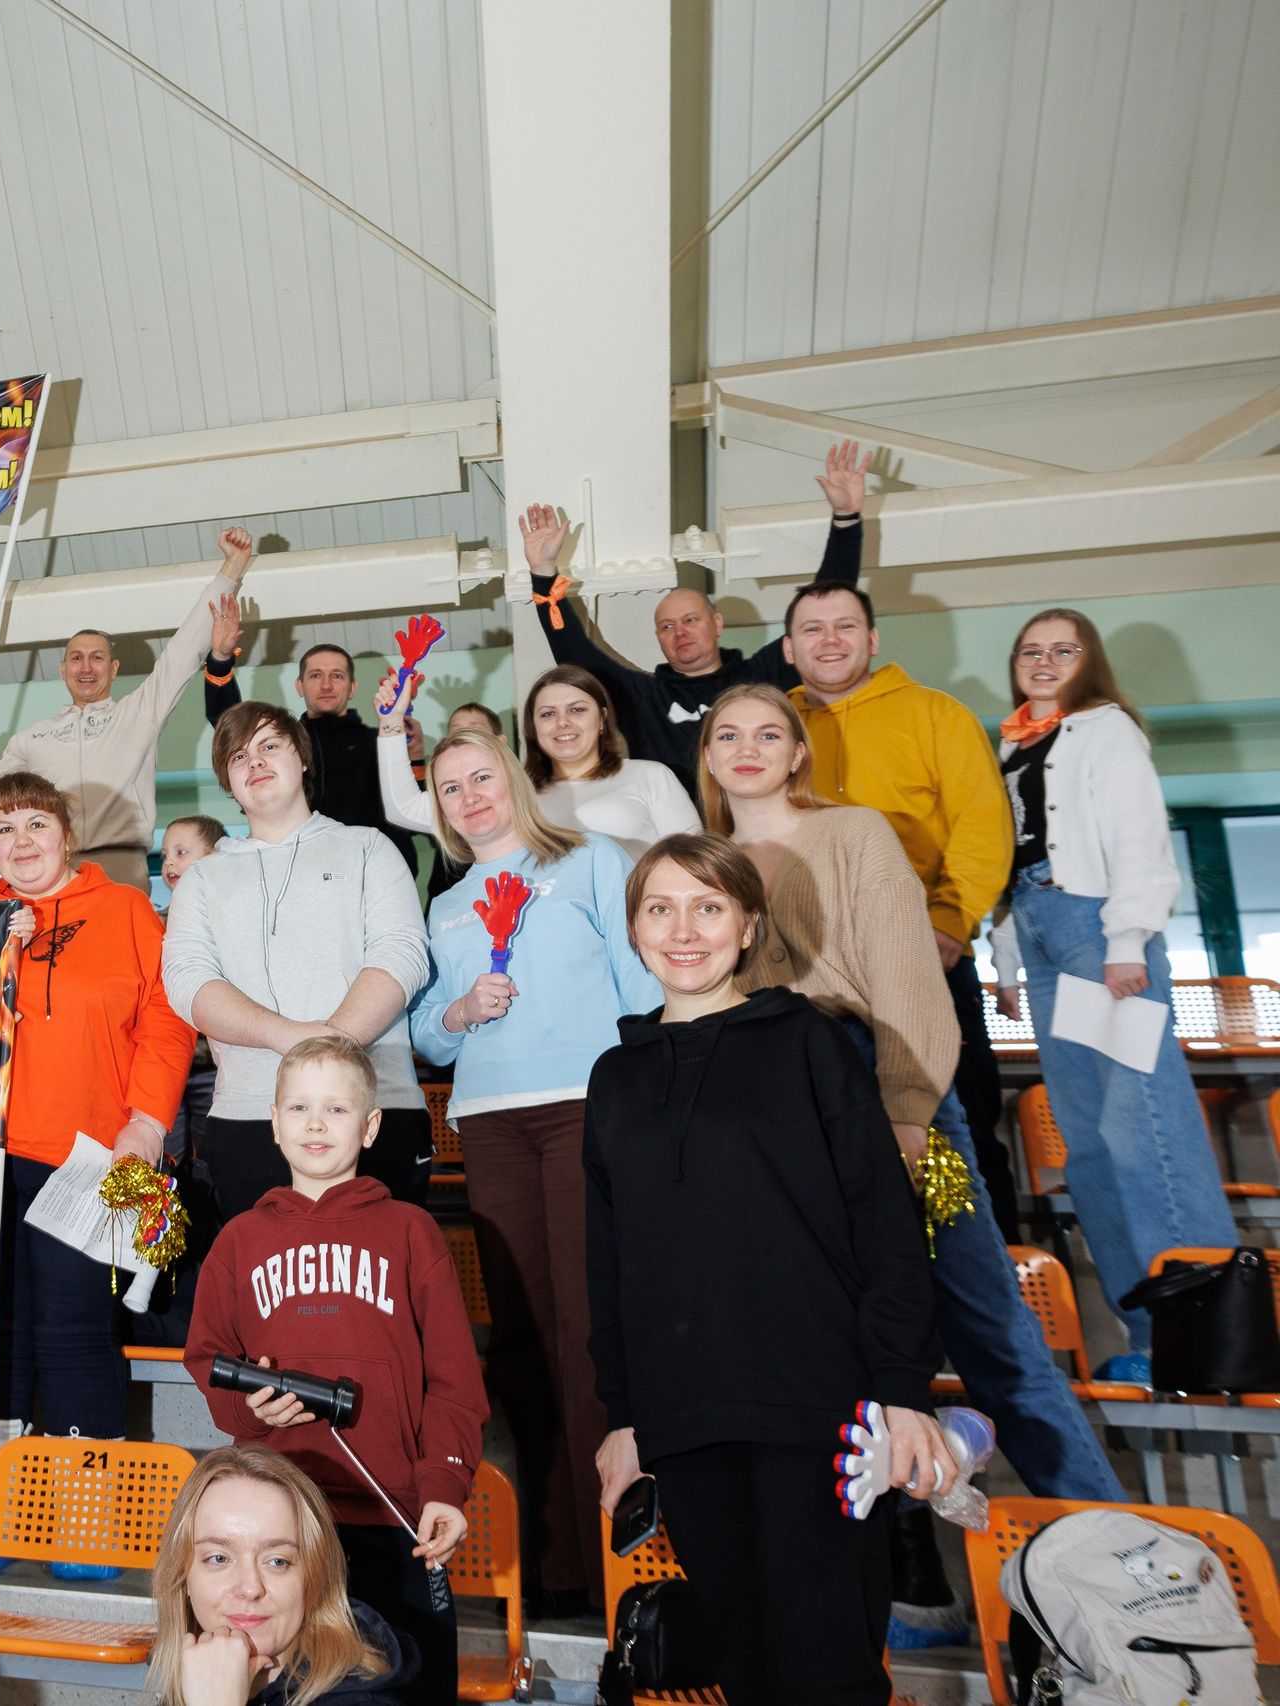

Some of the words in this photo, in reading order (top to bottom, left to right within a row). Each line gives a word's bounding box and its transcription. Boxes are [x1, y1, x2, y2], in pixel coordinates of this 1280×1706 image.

[428, 1091, 448, 1104] 22
[251, 1243, 394, 1320] ORIGINAL
[297, 1306, 318, 1316] FEEL
[321, 1305, 341, 1315] COOL
[82, 1450, 108, 1469] 21
